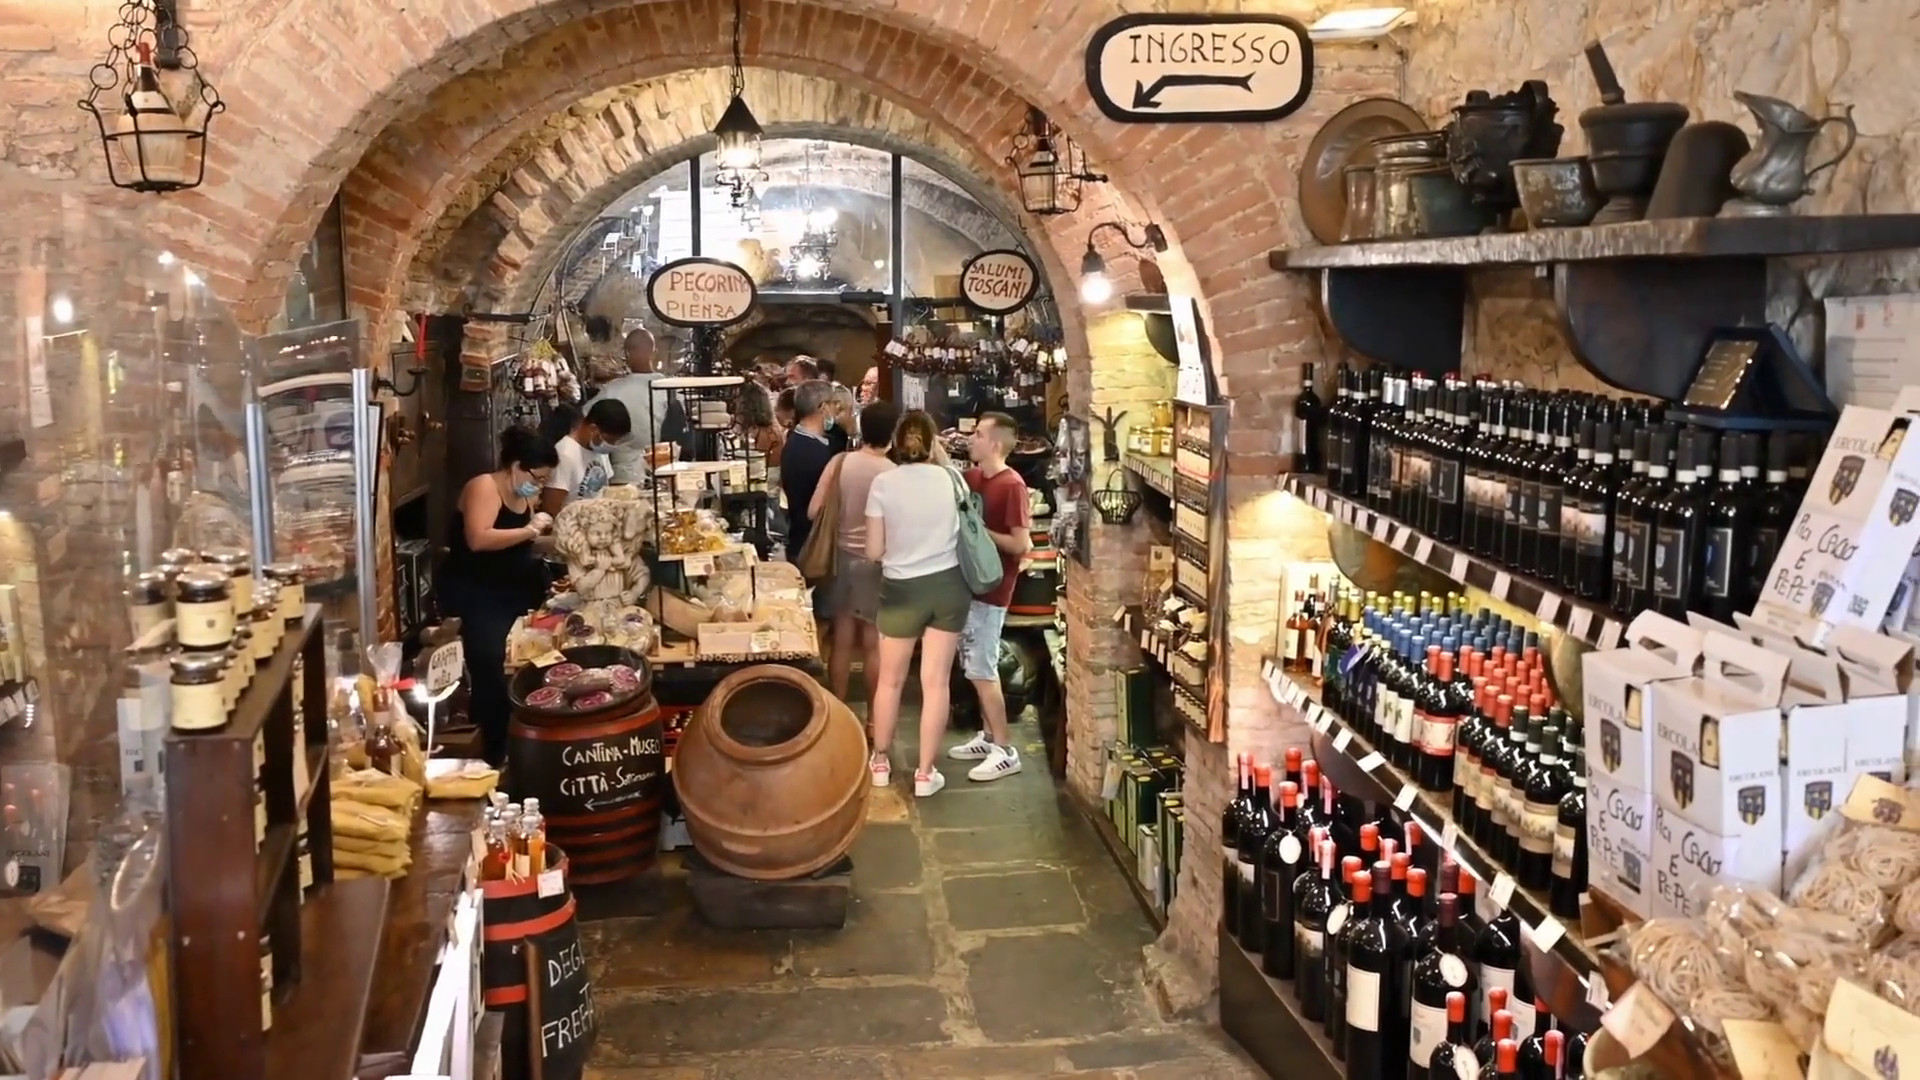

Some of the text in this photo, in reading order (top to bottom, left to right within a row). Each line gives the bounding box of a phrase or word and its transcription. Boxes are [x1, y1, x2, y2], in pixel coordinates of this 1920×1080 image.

[1129, 31, 1290, 66] INGRESSO
[970, 262, 1025, 280] SALUMI
[968, 276, 1027, 299] TOSCANI
[665, 300, 737, 320] PIENZA
